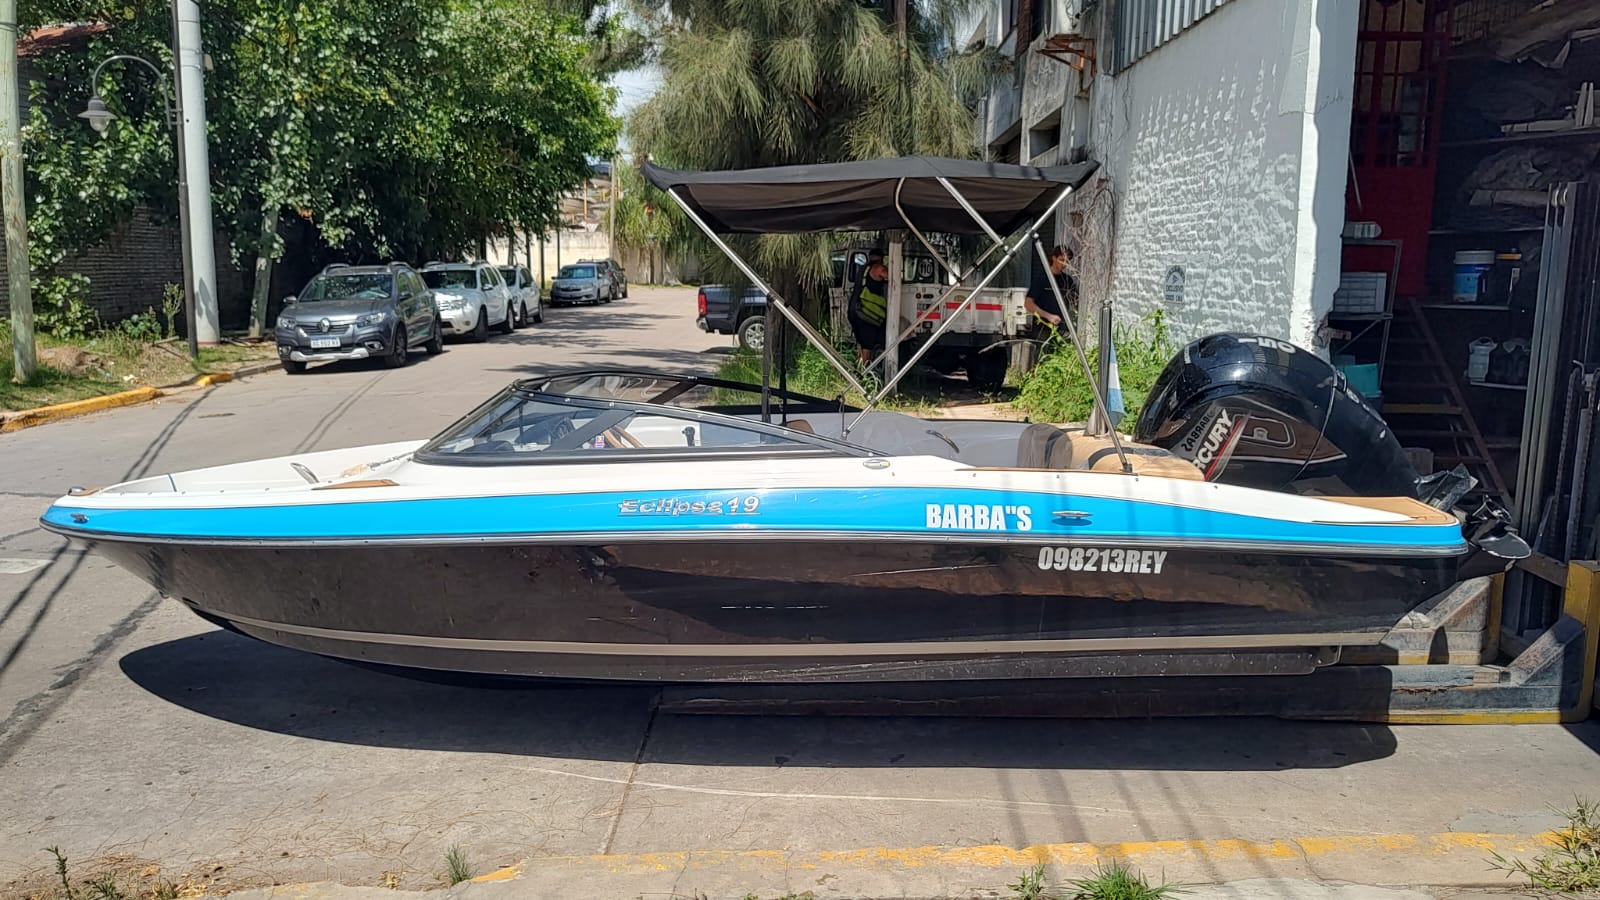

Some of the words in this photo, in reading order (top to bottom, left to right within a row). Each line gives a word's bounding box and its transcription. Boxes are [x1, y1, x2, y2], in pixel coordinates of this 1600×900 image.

[1192, 407, 1233, 470] RCURY
[727, 495, 760, 513] 19
[926, 503, 1032, 531] BARBA"S
[1038, 546, 1168, 574] 098213REY
